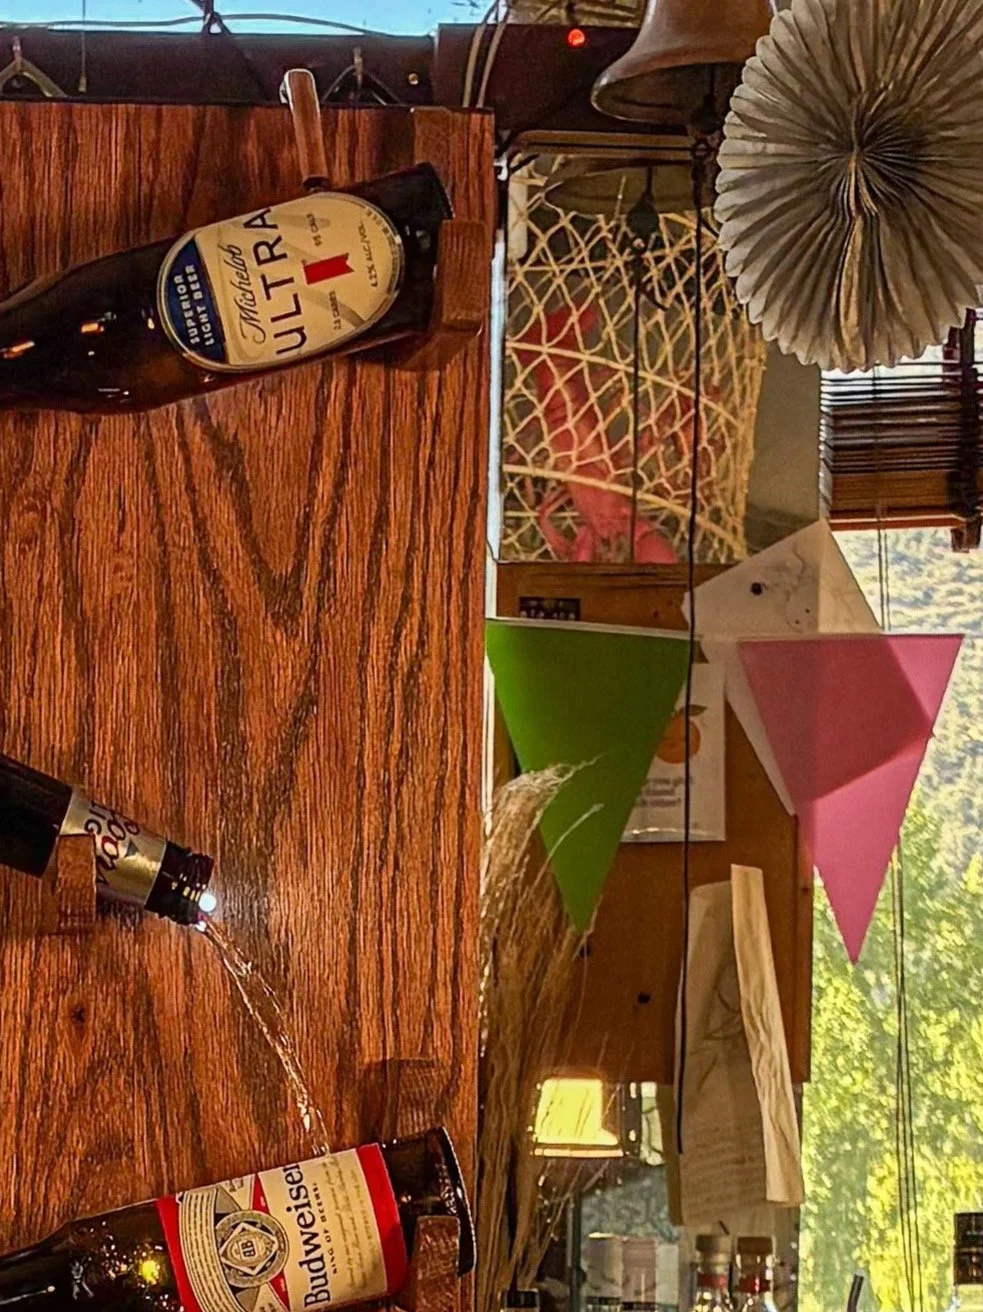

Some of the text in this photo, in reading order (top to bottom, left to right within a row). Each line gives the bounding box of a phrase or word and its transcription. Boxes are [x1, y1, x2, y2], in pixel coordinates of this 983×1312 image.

[173, 274, 201, 345] SUPERIOR
[186, 263, 215, 347] LIGHT BEER
[217, 243, 267, 346] Michelob
[242, 207, 308, 355] ULTRA
[282, 1162, 332, 1309] Budweiser
